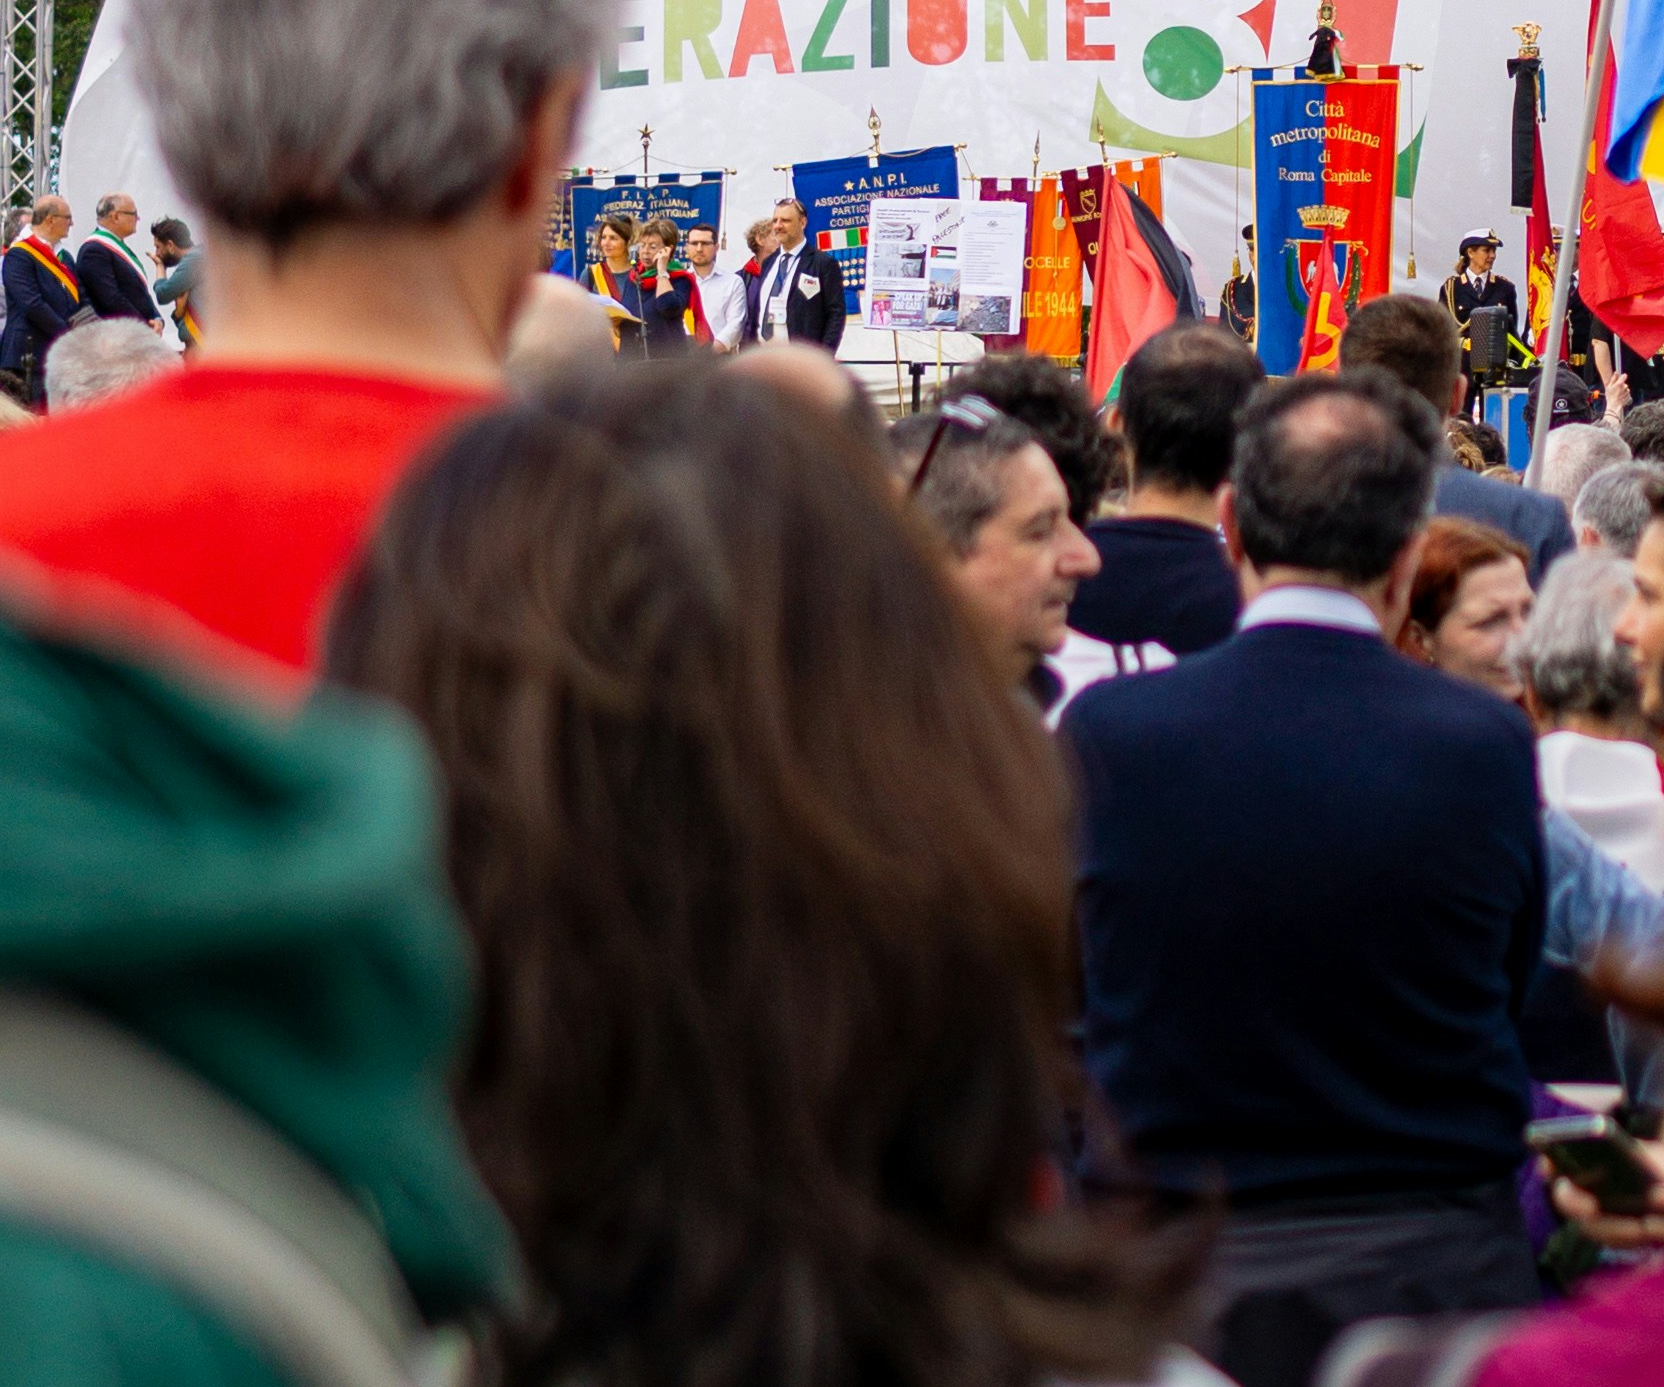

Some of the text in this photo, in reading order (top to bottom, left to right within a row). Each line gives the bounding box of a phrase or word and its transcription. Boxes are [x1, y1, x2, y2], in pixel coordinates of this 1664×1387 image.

[1305, 99, 1345, 118] Città
[1269, 122, 1381, 148] metropolitana
[1317, 149, 1331, 163] di
[1278, 166, 1372, 186] Roma Capitale
[887, 183, 940, 199] NAZIONALE
[1045, 292, 1077, 318] 1944
